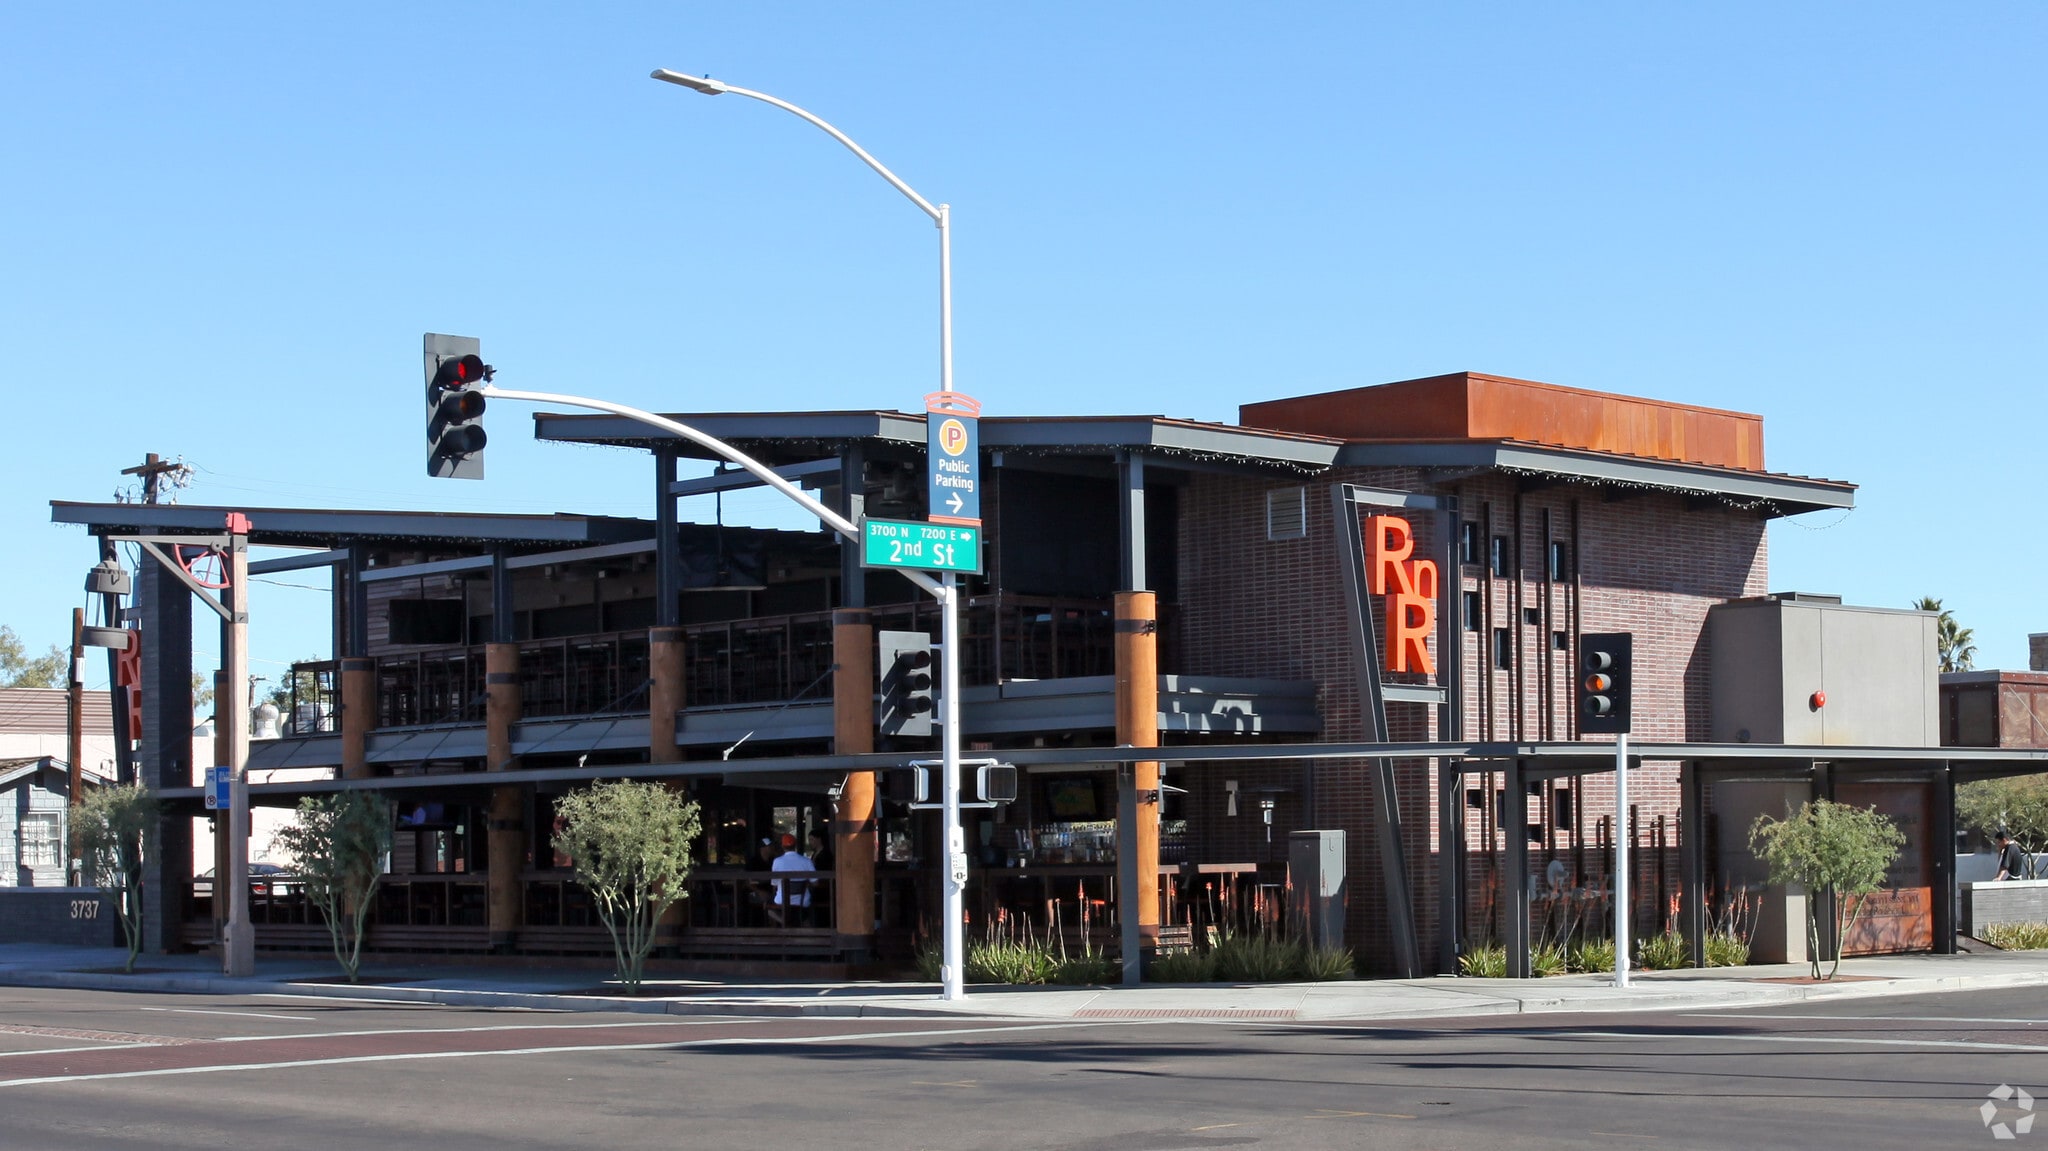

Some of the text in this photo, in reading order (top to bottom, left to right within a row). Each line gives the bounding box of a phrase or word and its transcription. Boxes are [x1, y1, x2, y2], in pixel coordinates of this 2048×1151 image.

[947, 426, 963, 448] P
[938, 458, 971, 474] Public
[935, 473, 974, 493] Parking
[870, 524, 957, 541] 3700 N 7200 E
[889, 539, 955, 567] 2nd St
[70, 900, 100, 919] 3737
